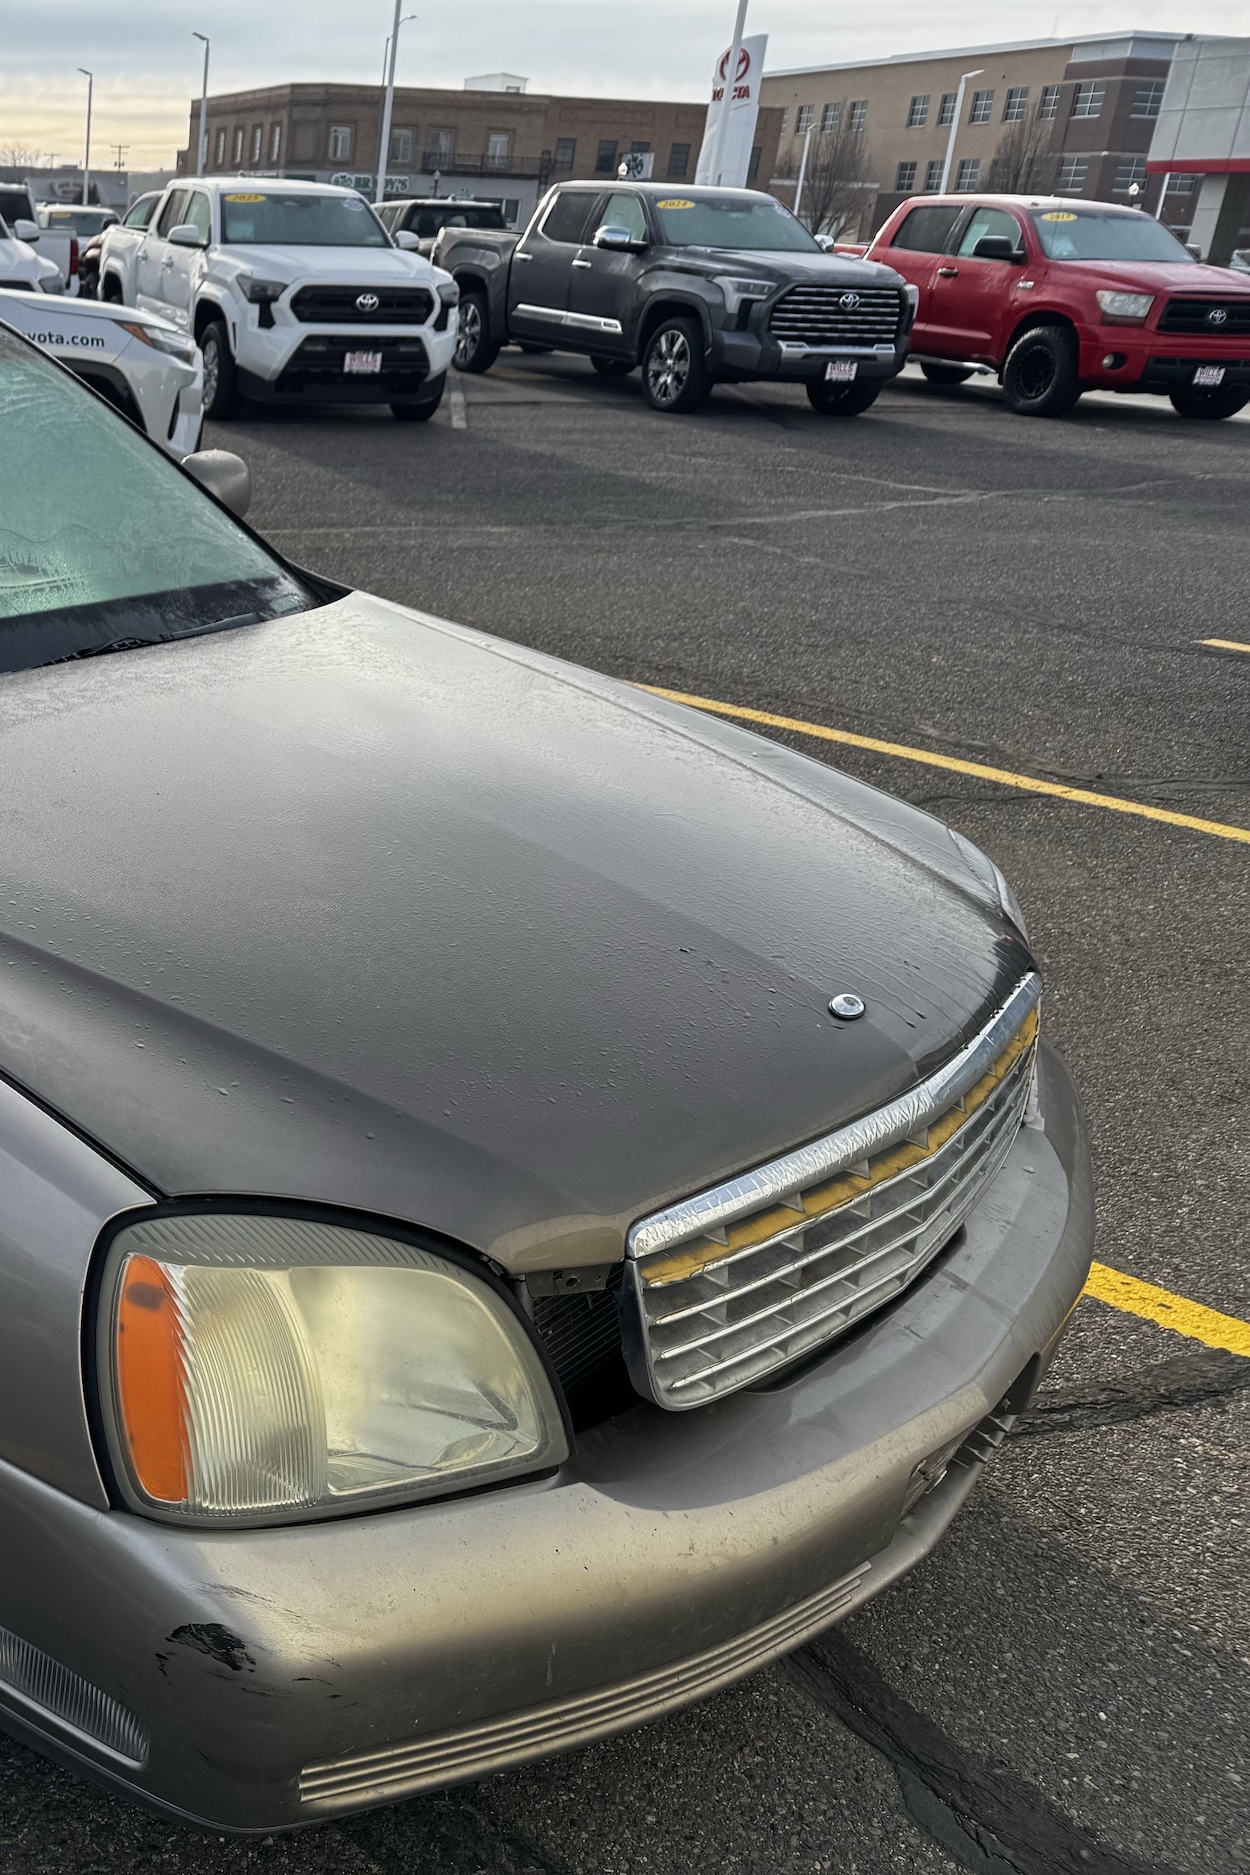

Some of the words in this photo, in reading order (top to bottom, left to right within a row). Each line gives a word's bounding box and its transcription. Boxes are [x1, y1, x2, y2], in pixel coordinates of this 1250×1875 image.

[712, 85, 750, 101] TOOTA
[354, 175, 408, 192] BRDY'S
[24, 331, 105, 347] yota.com
